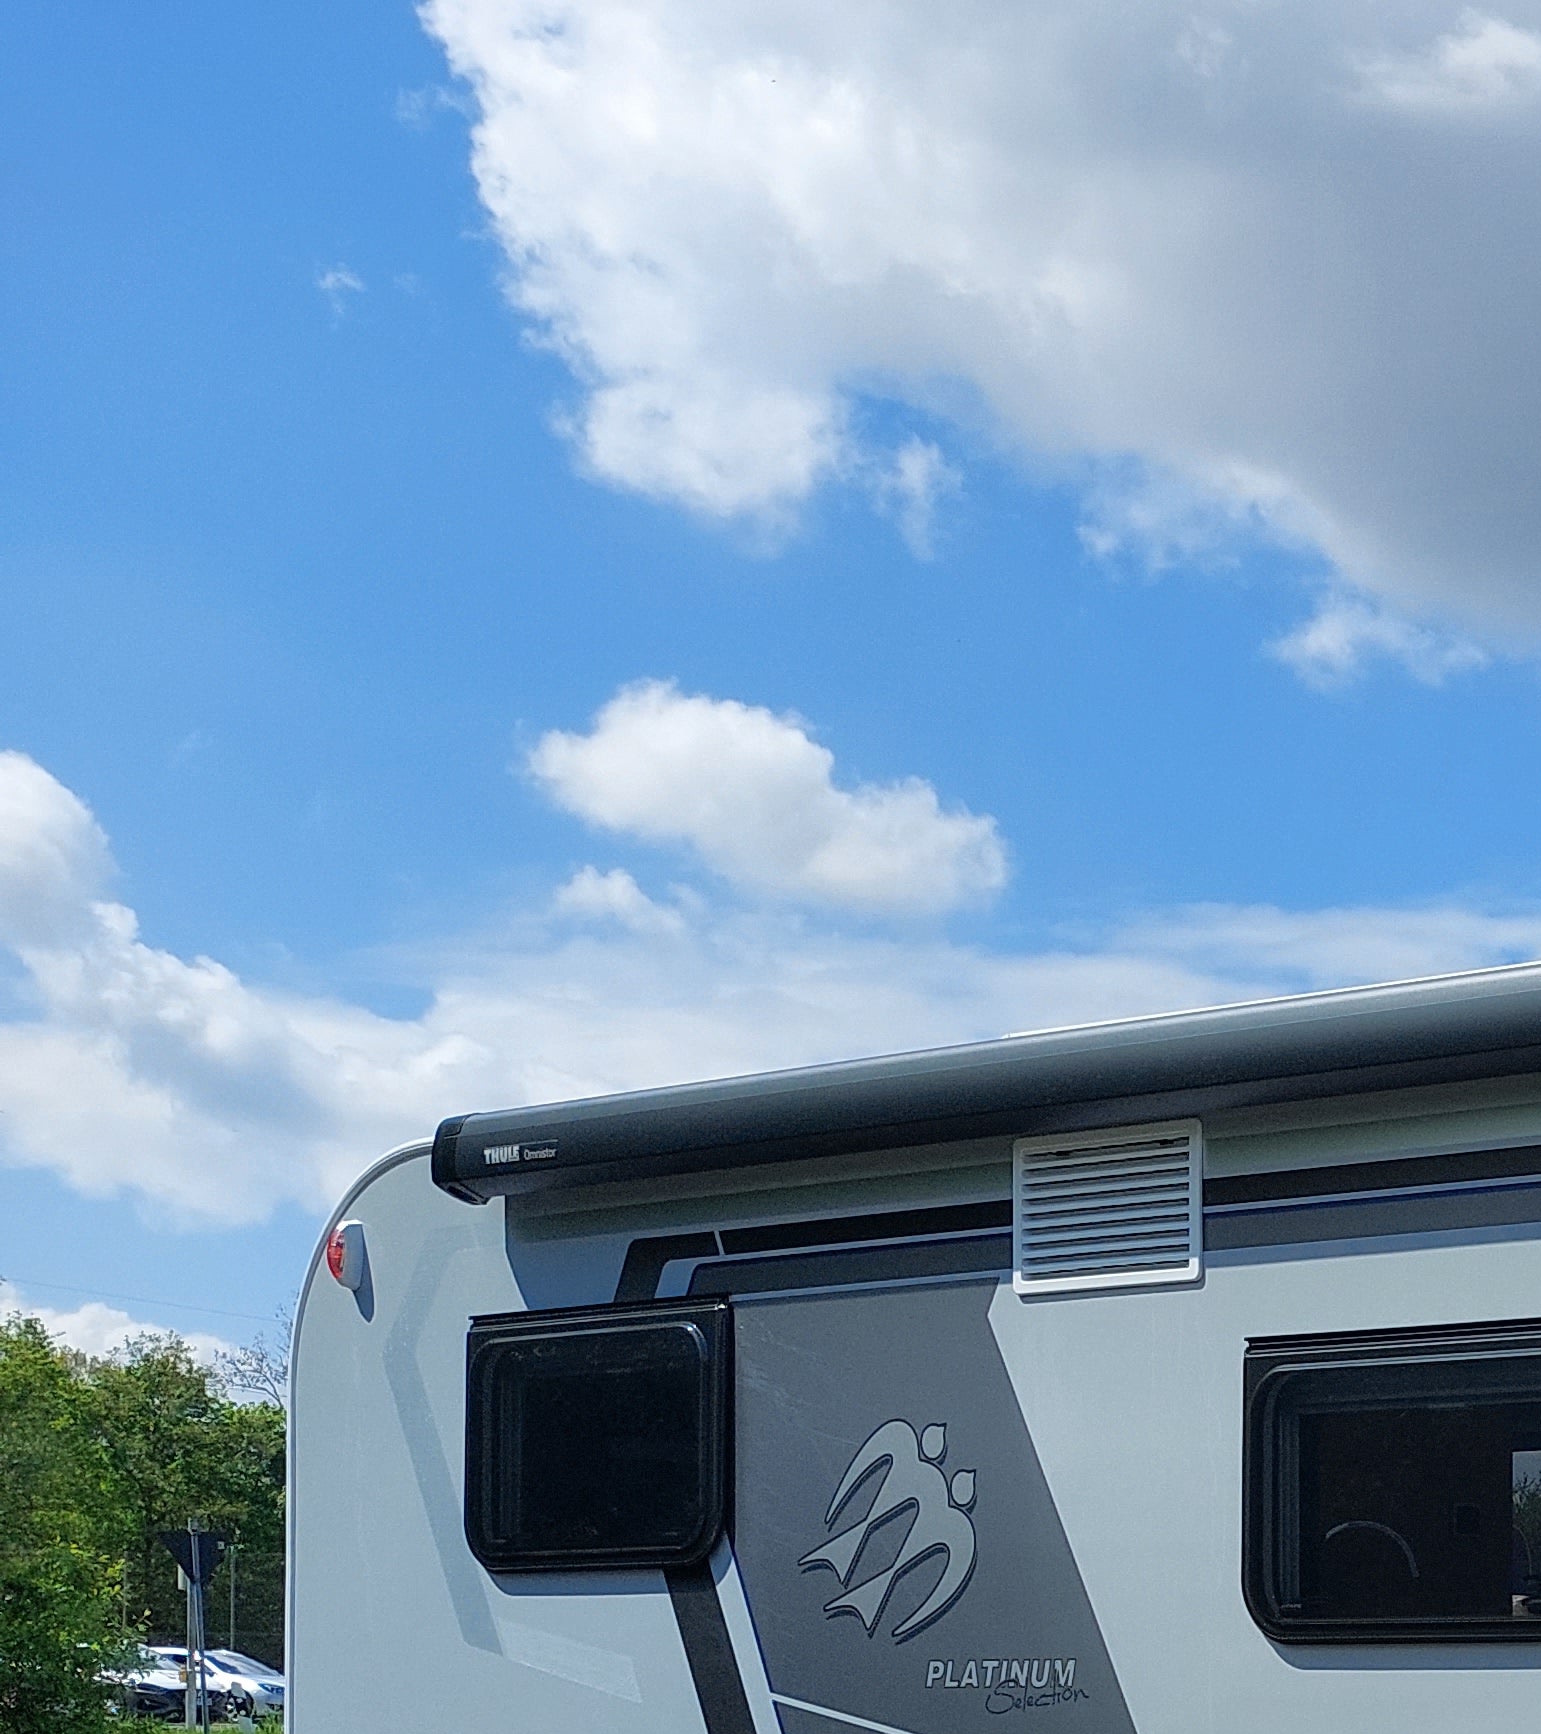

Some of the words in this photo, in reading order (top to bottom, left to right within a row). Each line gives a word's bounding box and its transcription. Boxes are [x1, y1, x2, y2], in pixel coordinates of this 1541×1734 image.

[484, 1145, 520, 1164] THULE
[925, 1658, 1077, 1688] PLATINUM
[985, 1679, 1089, 1714] Selection
